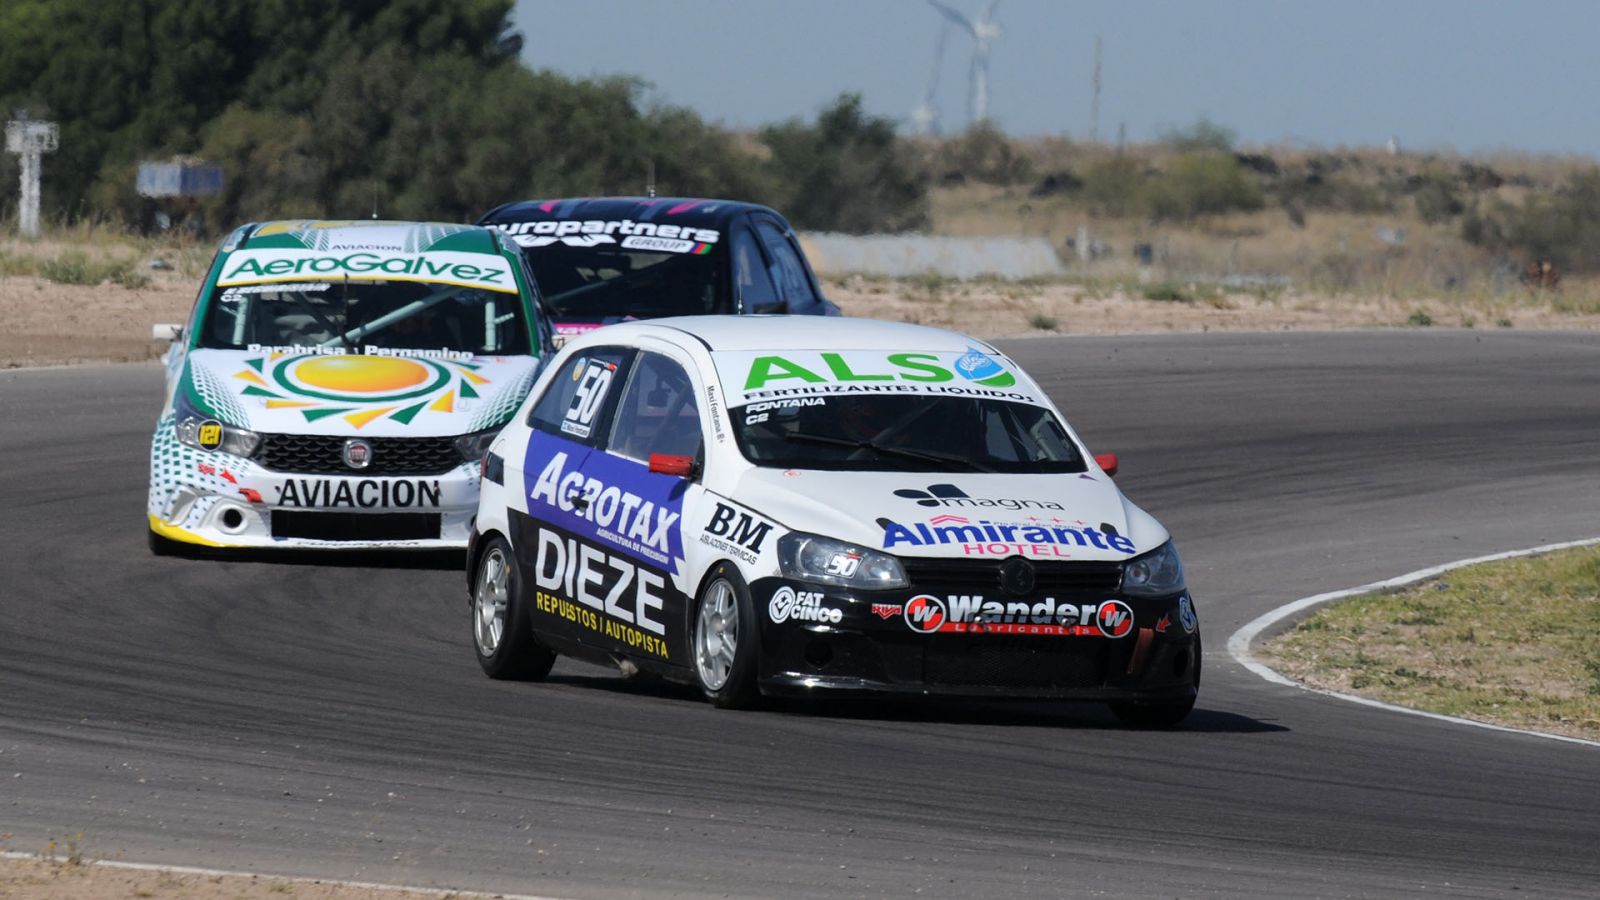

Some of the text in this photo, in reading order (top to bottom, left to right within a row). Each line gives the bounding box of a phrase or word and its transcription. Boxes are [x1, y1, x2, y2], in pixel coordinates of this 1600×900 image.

[629, 237, 688, 250] GROUP
[226, 253, 505, 284] AeroGalvez
[565, 364, 612, 424] 50
[745, 397, 826, 413] FONTANA
[745, 413, 769, 426] C2
[277, 479, 440, 508] AVIACION
[530, 451, 680, 554] AGROTAX
[937, 497, 1066, 511] magna
[704, 502, 774, 555] BM
[883, 519, 1137, 555] Almirante
[963, 543, 1071, 558] HOTEL
[535, 527, 666, 636] DIEZE
[790, 604, 843, 624] CINCO
[795, 591, 825, 607] FAT
[947, 594, 1097, 627] Wander
[536, 591, 598, 631] REPUESTOS
[606, 619, 670, 659] AUTOPISTA
